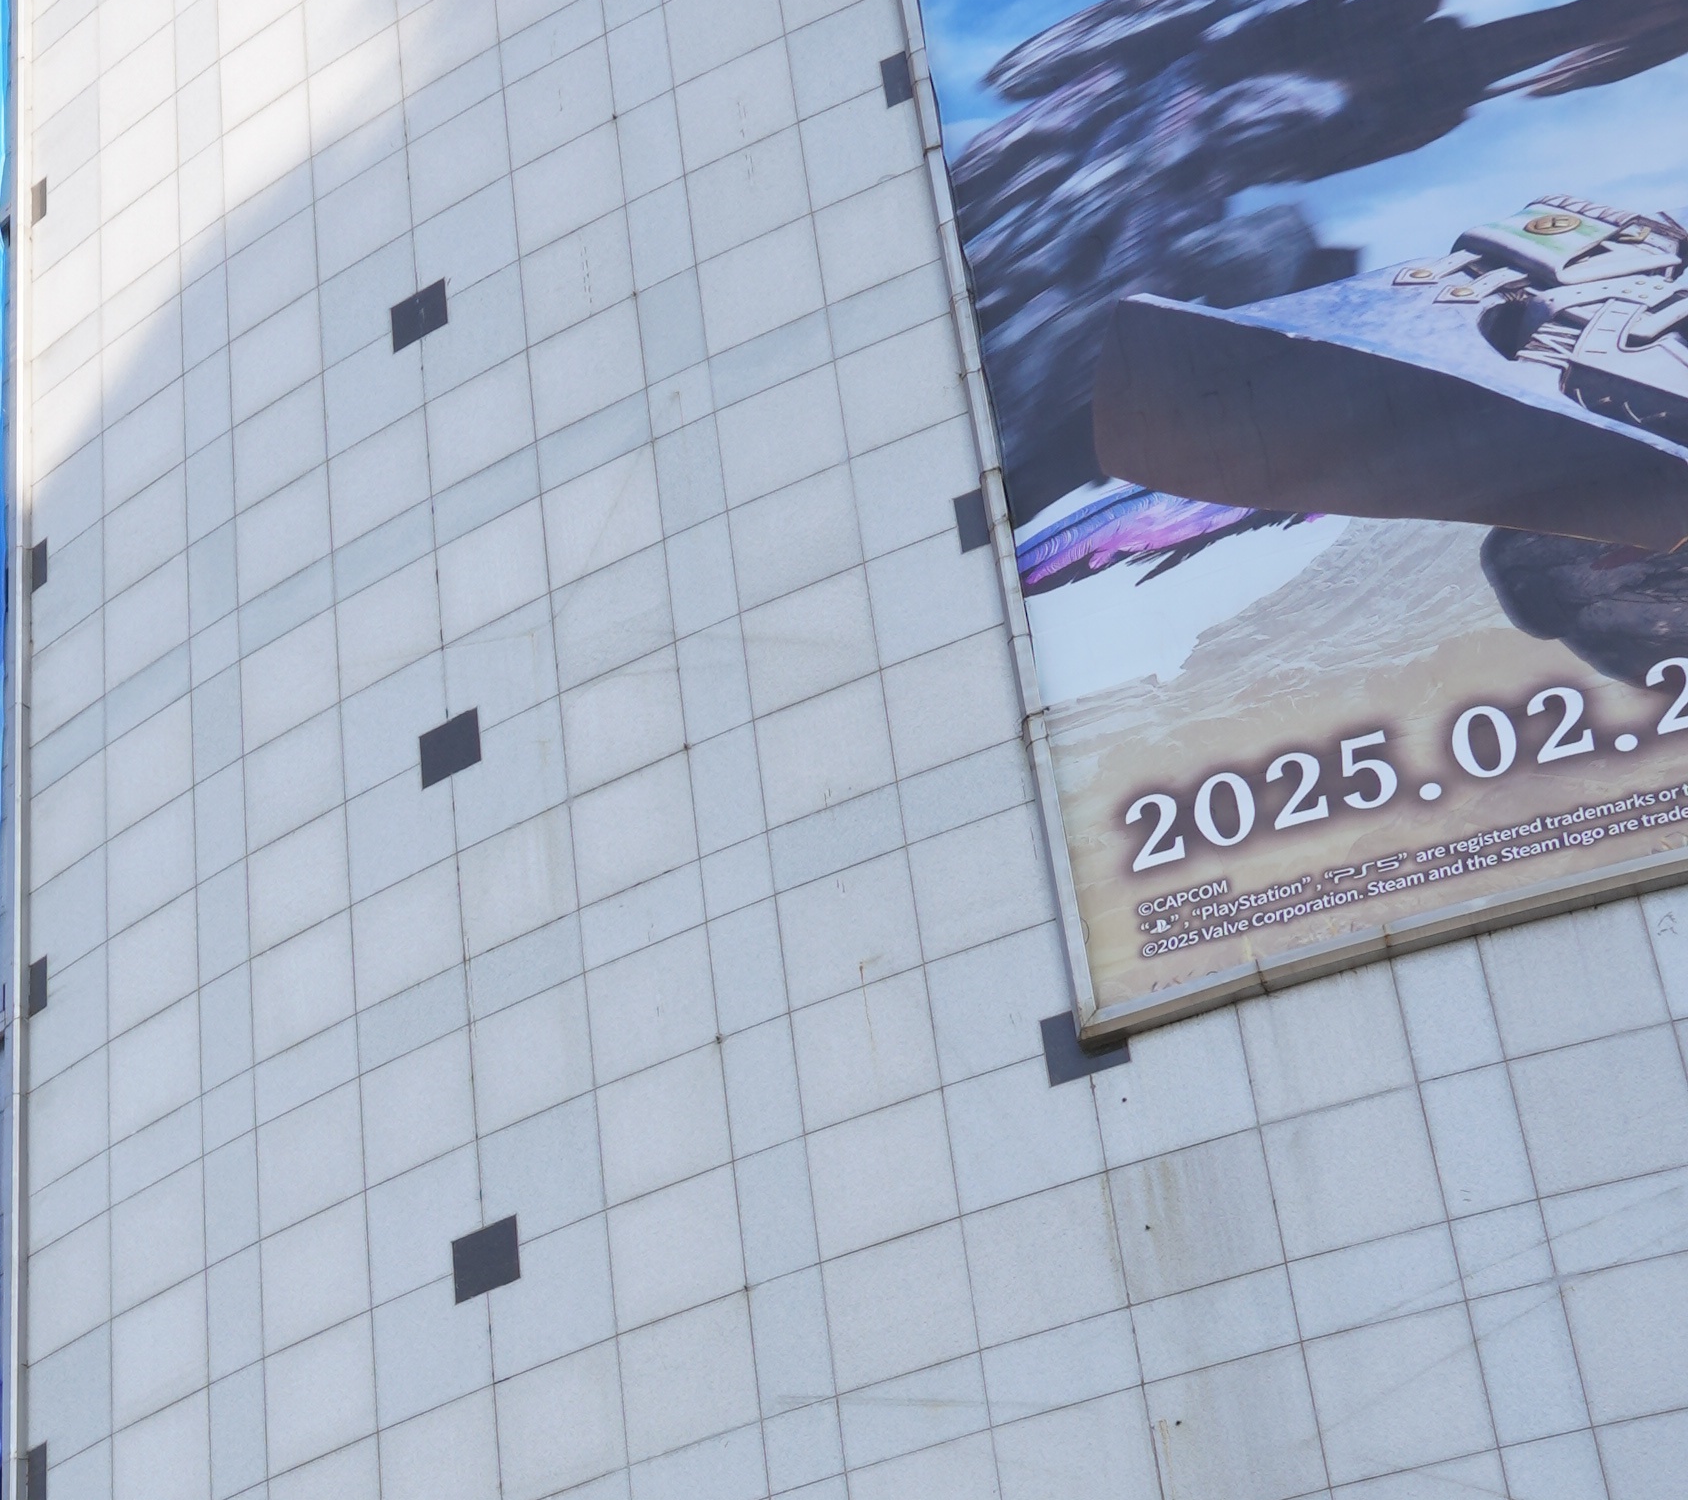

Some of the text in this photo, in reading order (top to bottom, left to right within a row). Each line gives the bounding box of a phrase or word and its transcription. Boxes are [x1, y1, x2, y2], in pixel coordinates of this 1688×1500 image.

[1416, 844, 1445, 864] are
[1449, 817, 1542, 854] registered
[1545, 793, 1655, 829] trademarks
[1658, 787, 1680, 803] or
[1142, 930, 1199, 958] ©2025
[1201, 917, 1249, 941] Valve
[1252, 888, 1364, 927] Corporation.
[1368, 871, 1425, 896] Steam
[1428, 859, 1463, 882] and
[1467, 849, 1498, 871] the
[1501, 837, 1560, 862] Steam
[1562, 827, 1605, 847] logo
[1608, 818, 1639, 836] are
